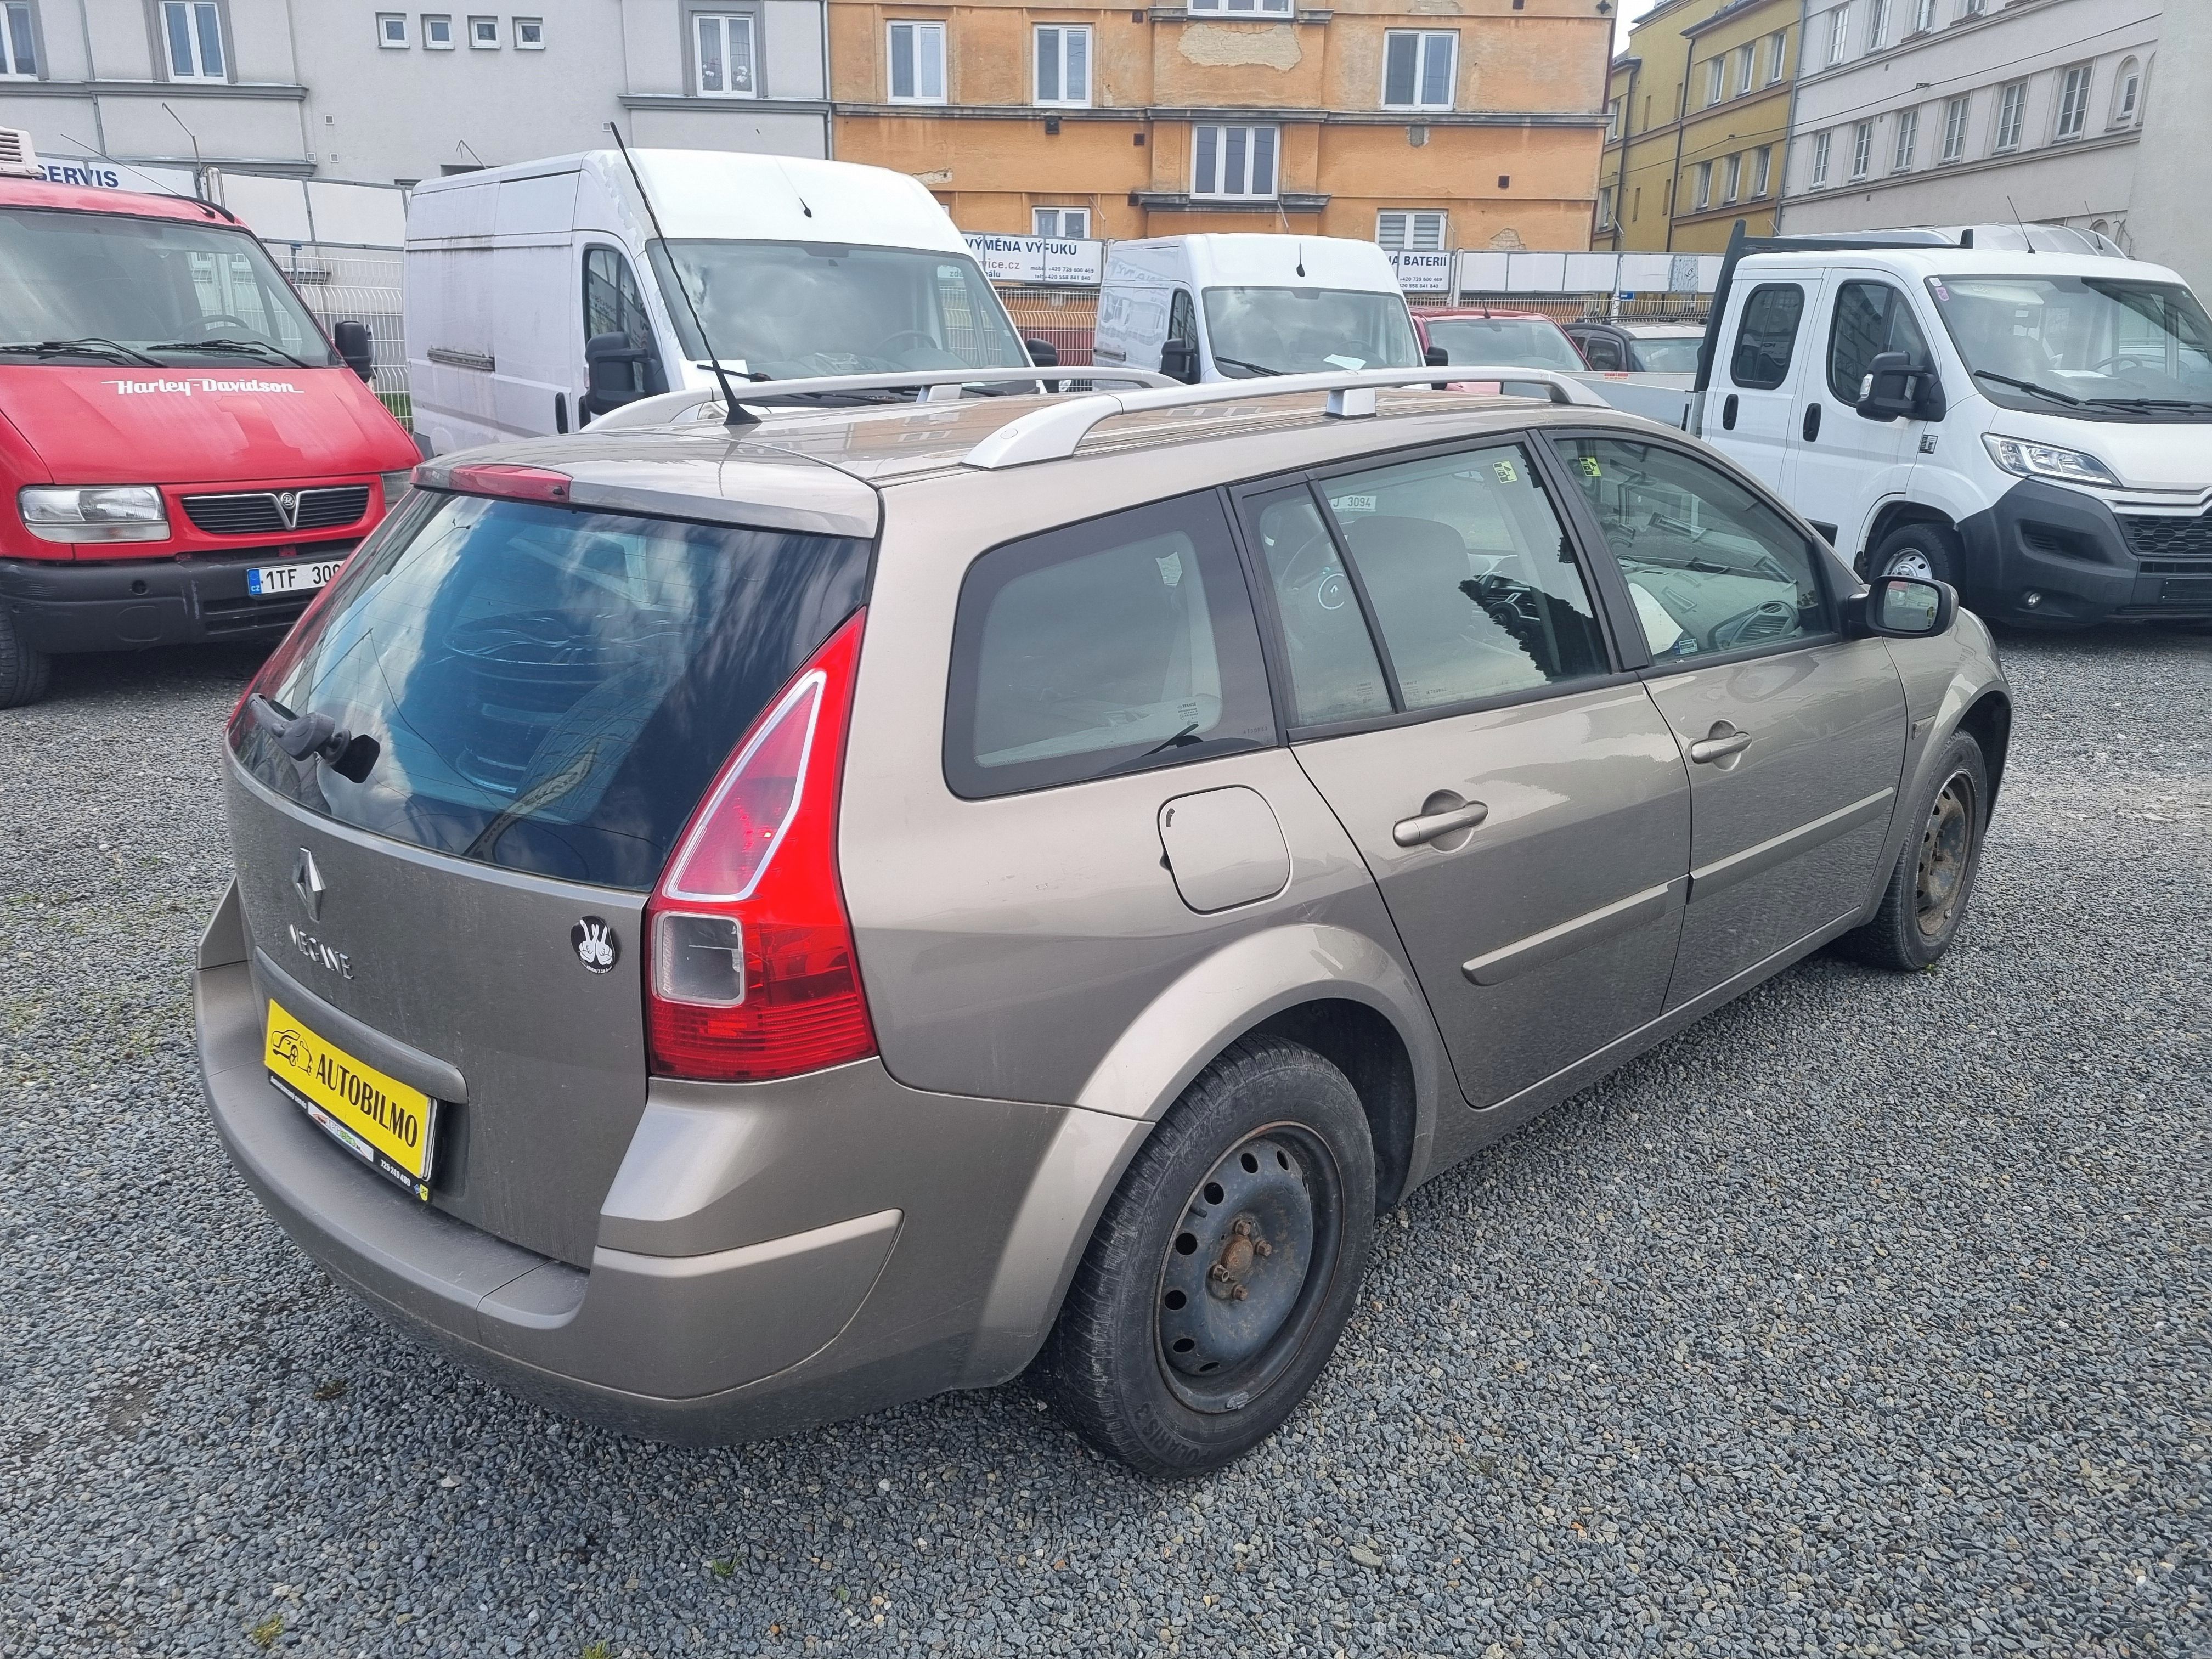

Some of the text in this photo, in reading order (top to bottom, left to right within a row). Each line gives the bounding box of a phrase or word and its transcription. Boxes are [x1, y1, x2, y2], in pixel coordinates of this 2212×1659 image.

[965, 237, 1022, 252] VÝMĚNA
[1403, 255, 1448, 266] BATERIÍ
[101, 379, 304, 396] Harley-Davidson
[1347, 496, 1371, 507] 3094
[266, 568, 297, 590] 1TF
[315, 1053, 418, 1148] AUTOBILMO
[380, 1159, 411, 1187] 725 249 489
